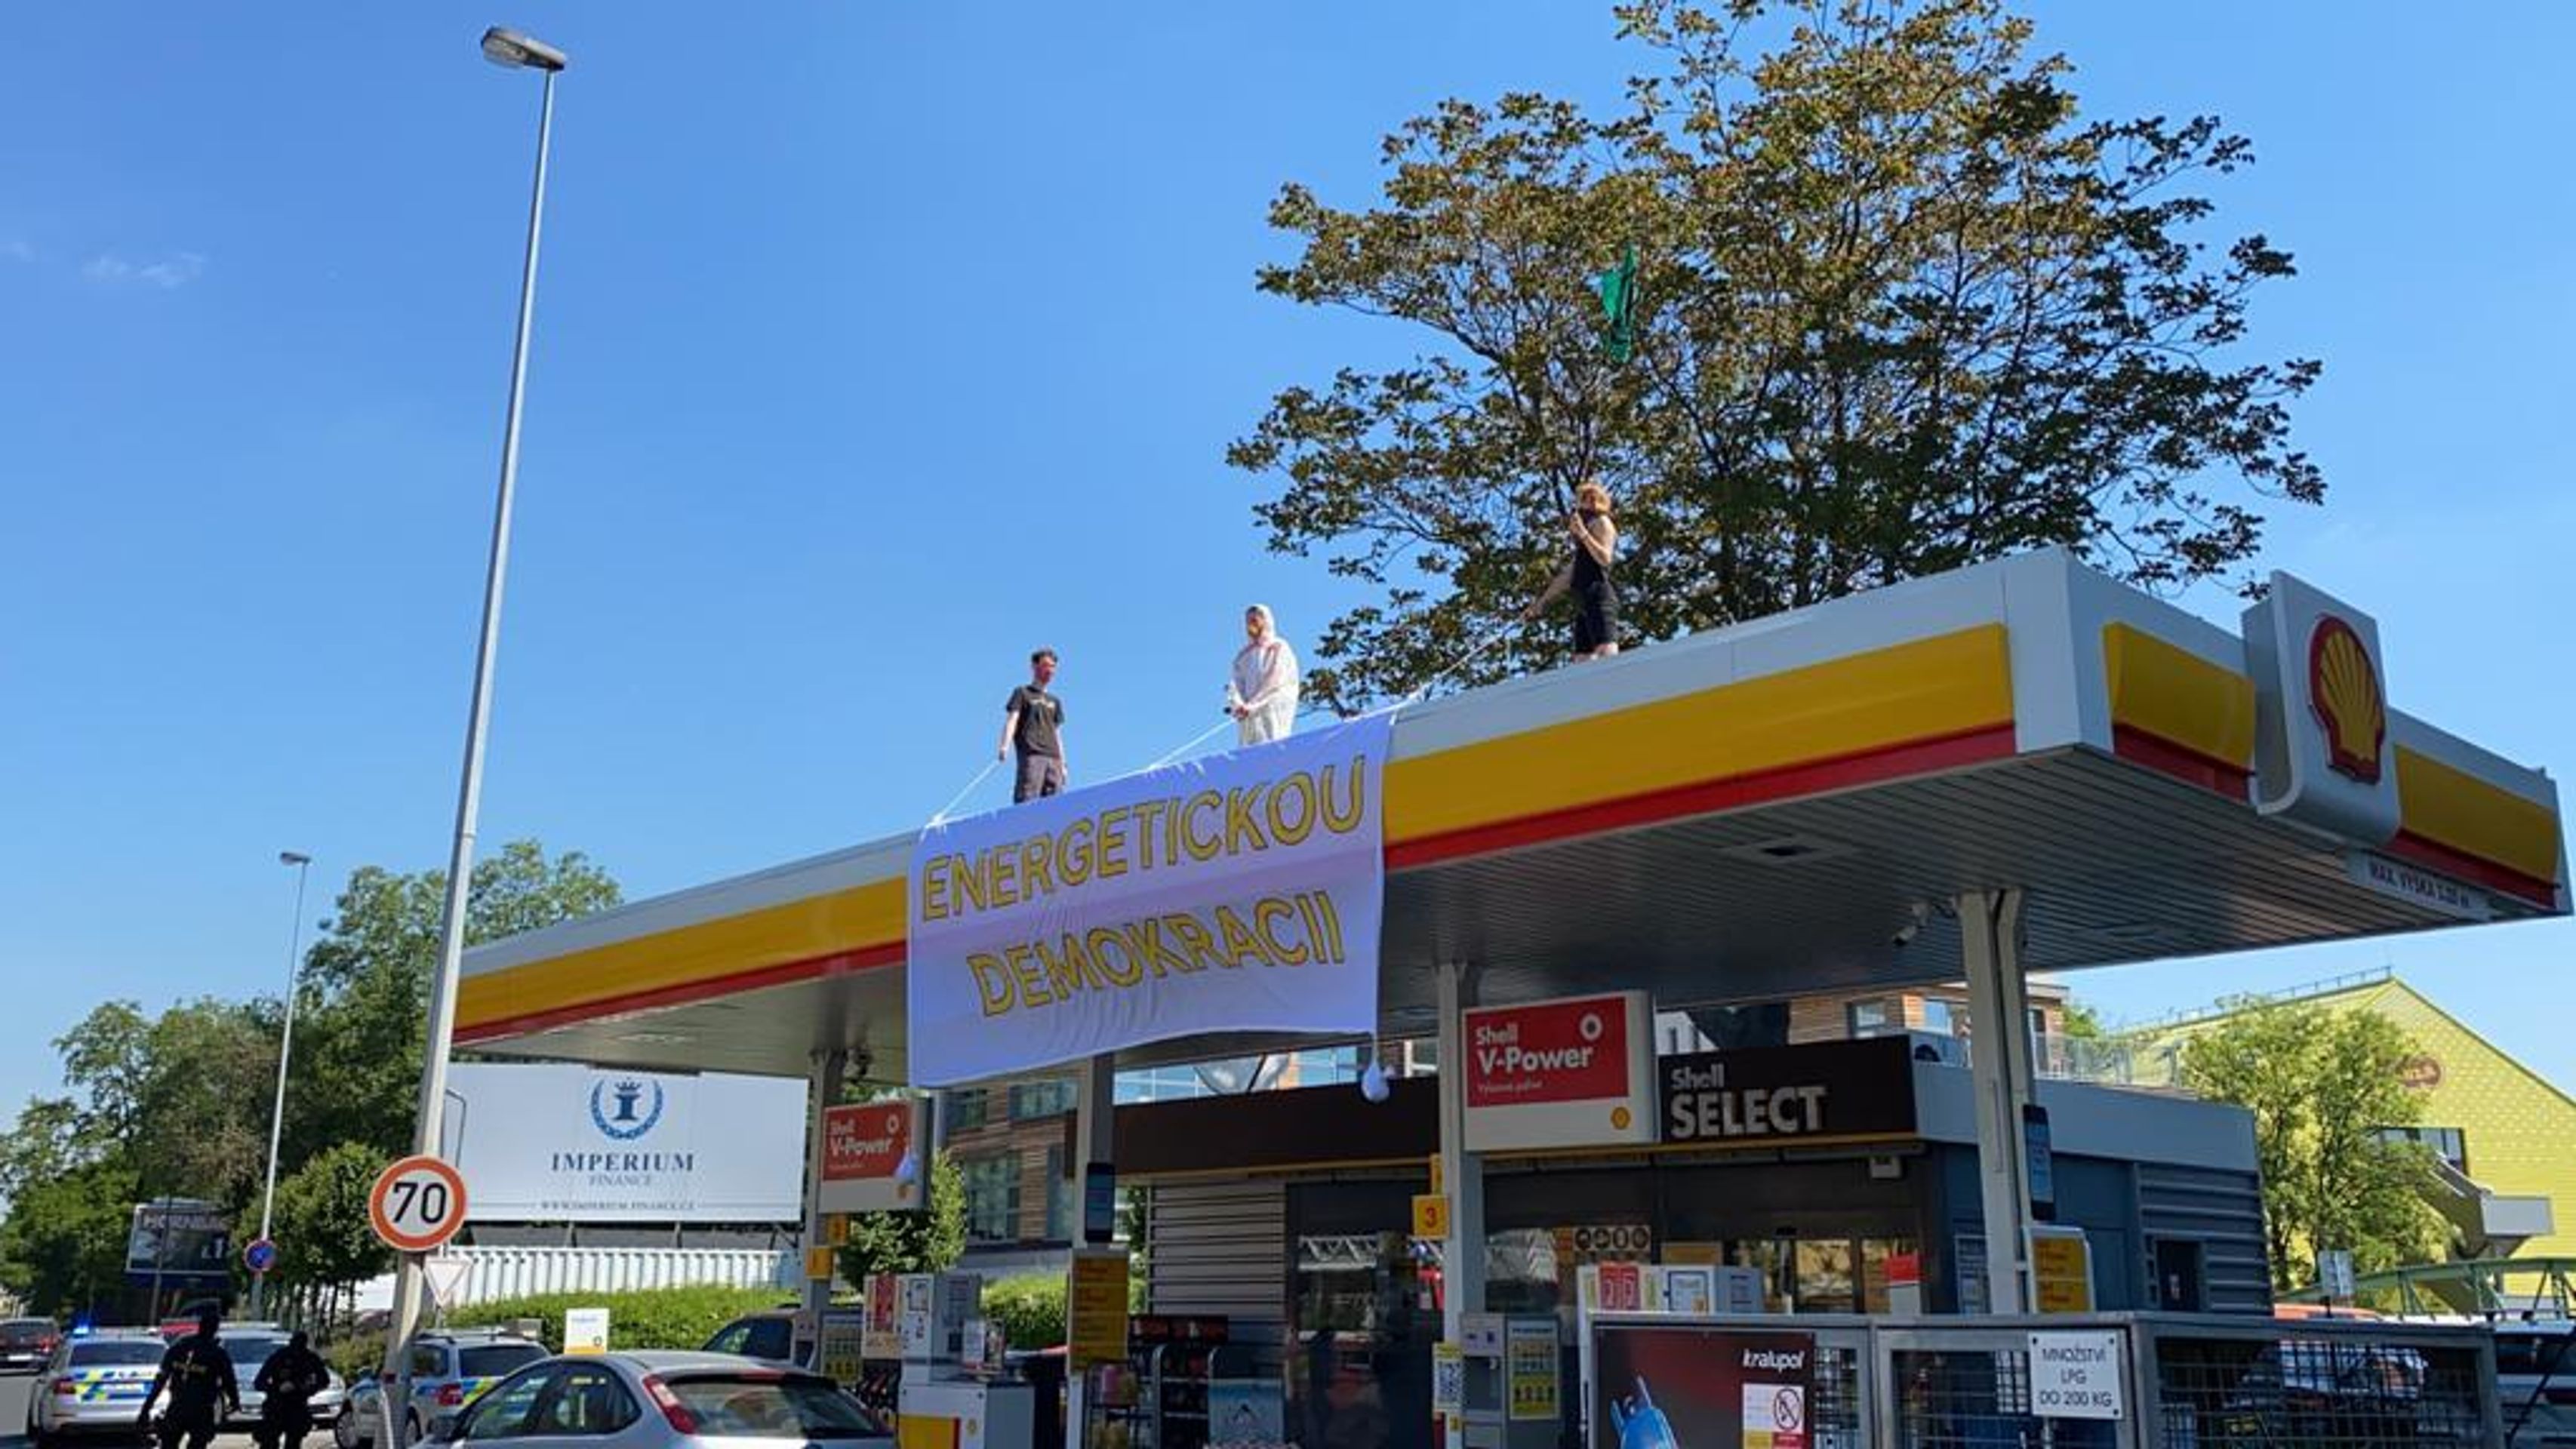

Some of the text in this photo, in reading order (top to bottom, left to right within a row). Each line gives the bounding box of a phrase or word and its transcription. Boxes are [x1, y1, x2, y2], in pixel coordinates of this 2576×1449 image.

[921, 755, 1365, 922] ENERGETICKOU
[967, 890, 1346, 1018] DEMOKRACII
[1476, 1023, 1519, 1045] Shell
[1476, 1046, 1594, 1075] V-Power
[1671, 1063, 1725, 1090] Shell
[1670, 1085, 1827, 1139] SELECT
[831, 1137, 894, 1158] V-Power
[552, 1152, 694, 1172] IMPERIUM
[589, 1174, 652, 1186] FINANCE
[393, 1182, 447, 1224] 70
[1425, 1206, 1438, 1229] 3
[1743, 1348, 1805, 1374] kralupol
[2060, 1369, 2087, 1385] LPG
[2040, 1391, 2113, 1407] DO 200 KG
